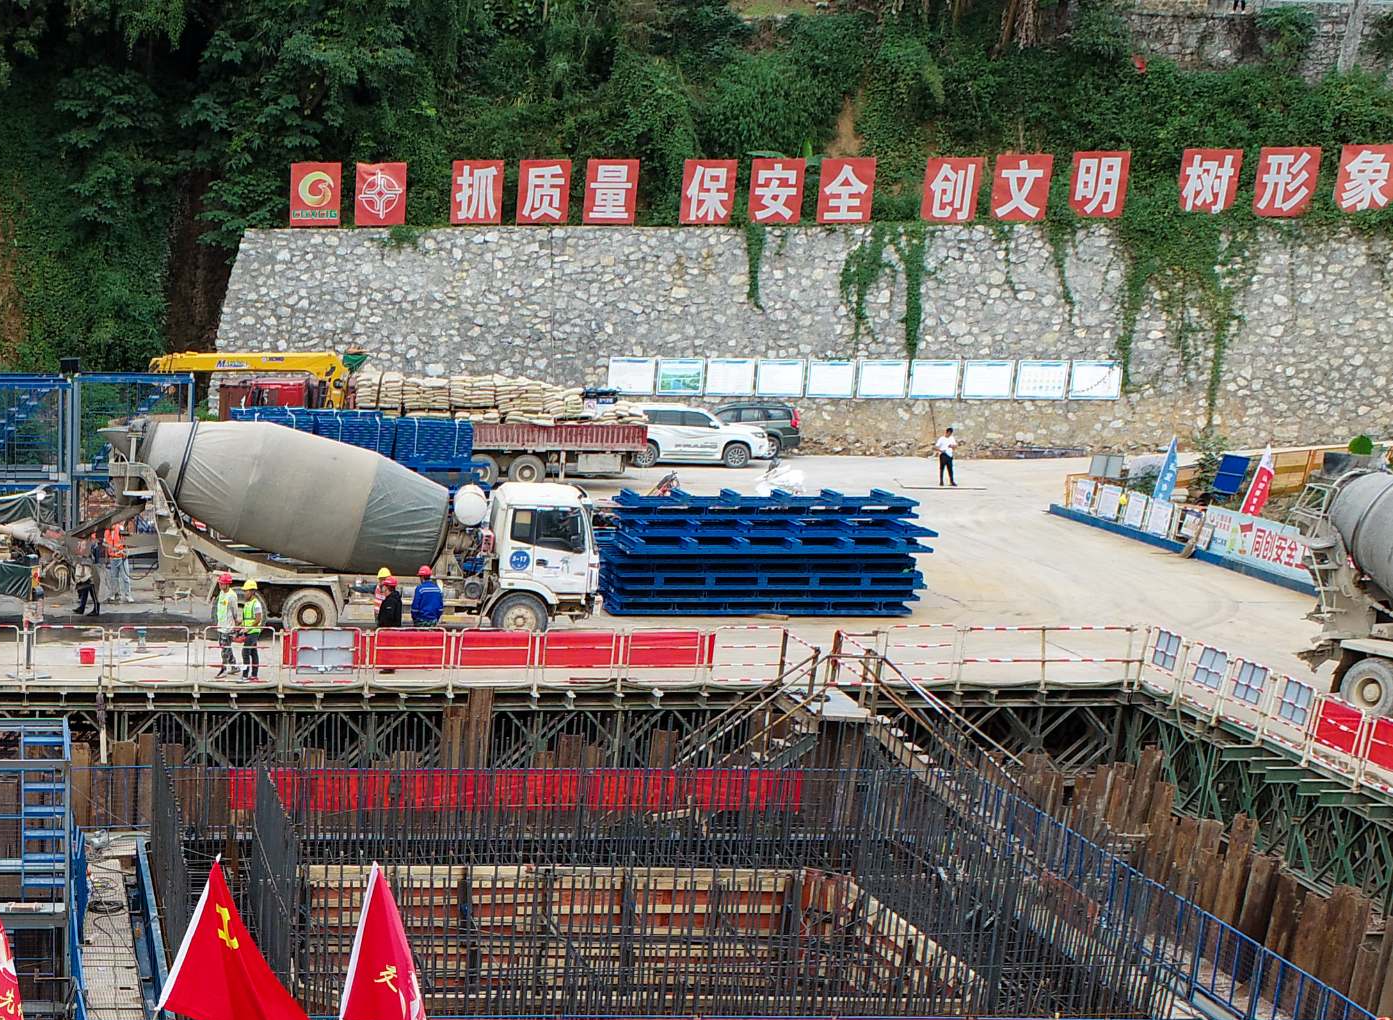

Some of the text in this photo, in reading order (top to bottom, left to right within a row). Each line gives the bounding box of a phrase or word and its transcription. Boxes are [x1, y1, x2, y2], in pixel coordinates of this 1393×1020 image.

[456, 150, 1391, 220] 抓质量 保安全 创文明 树形象
